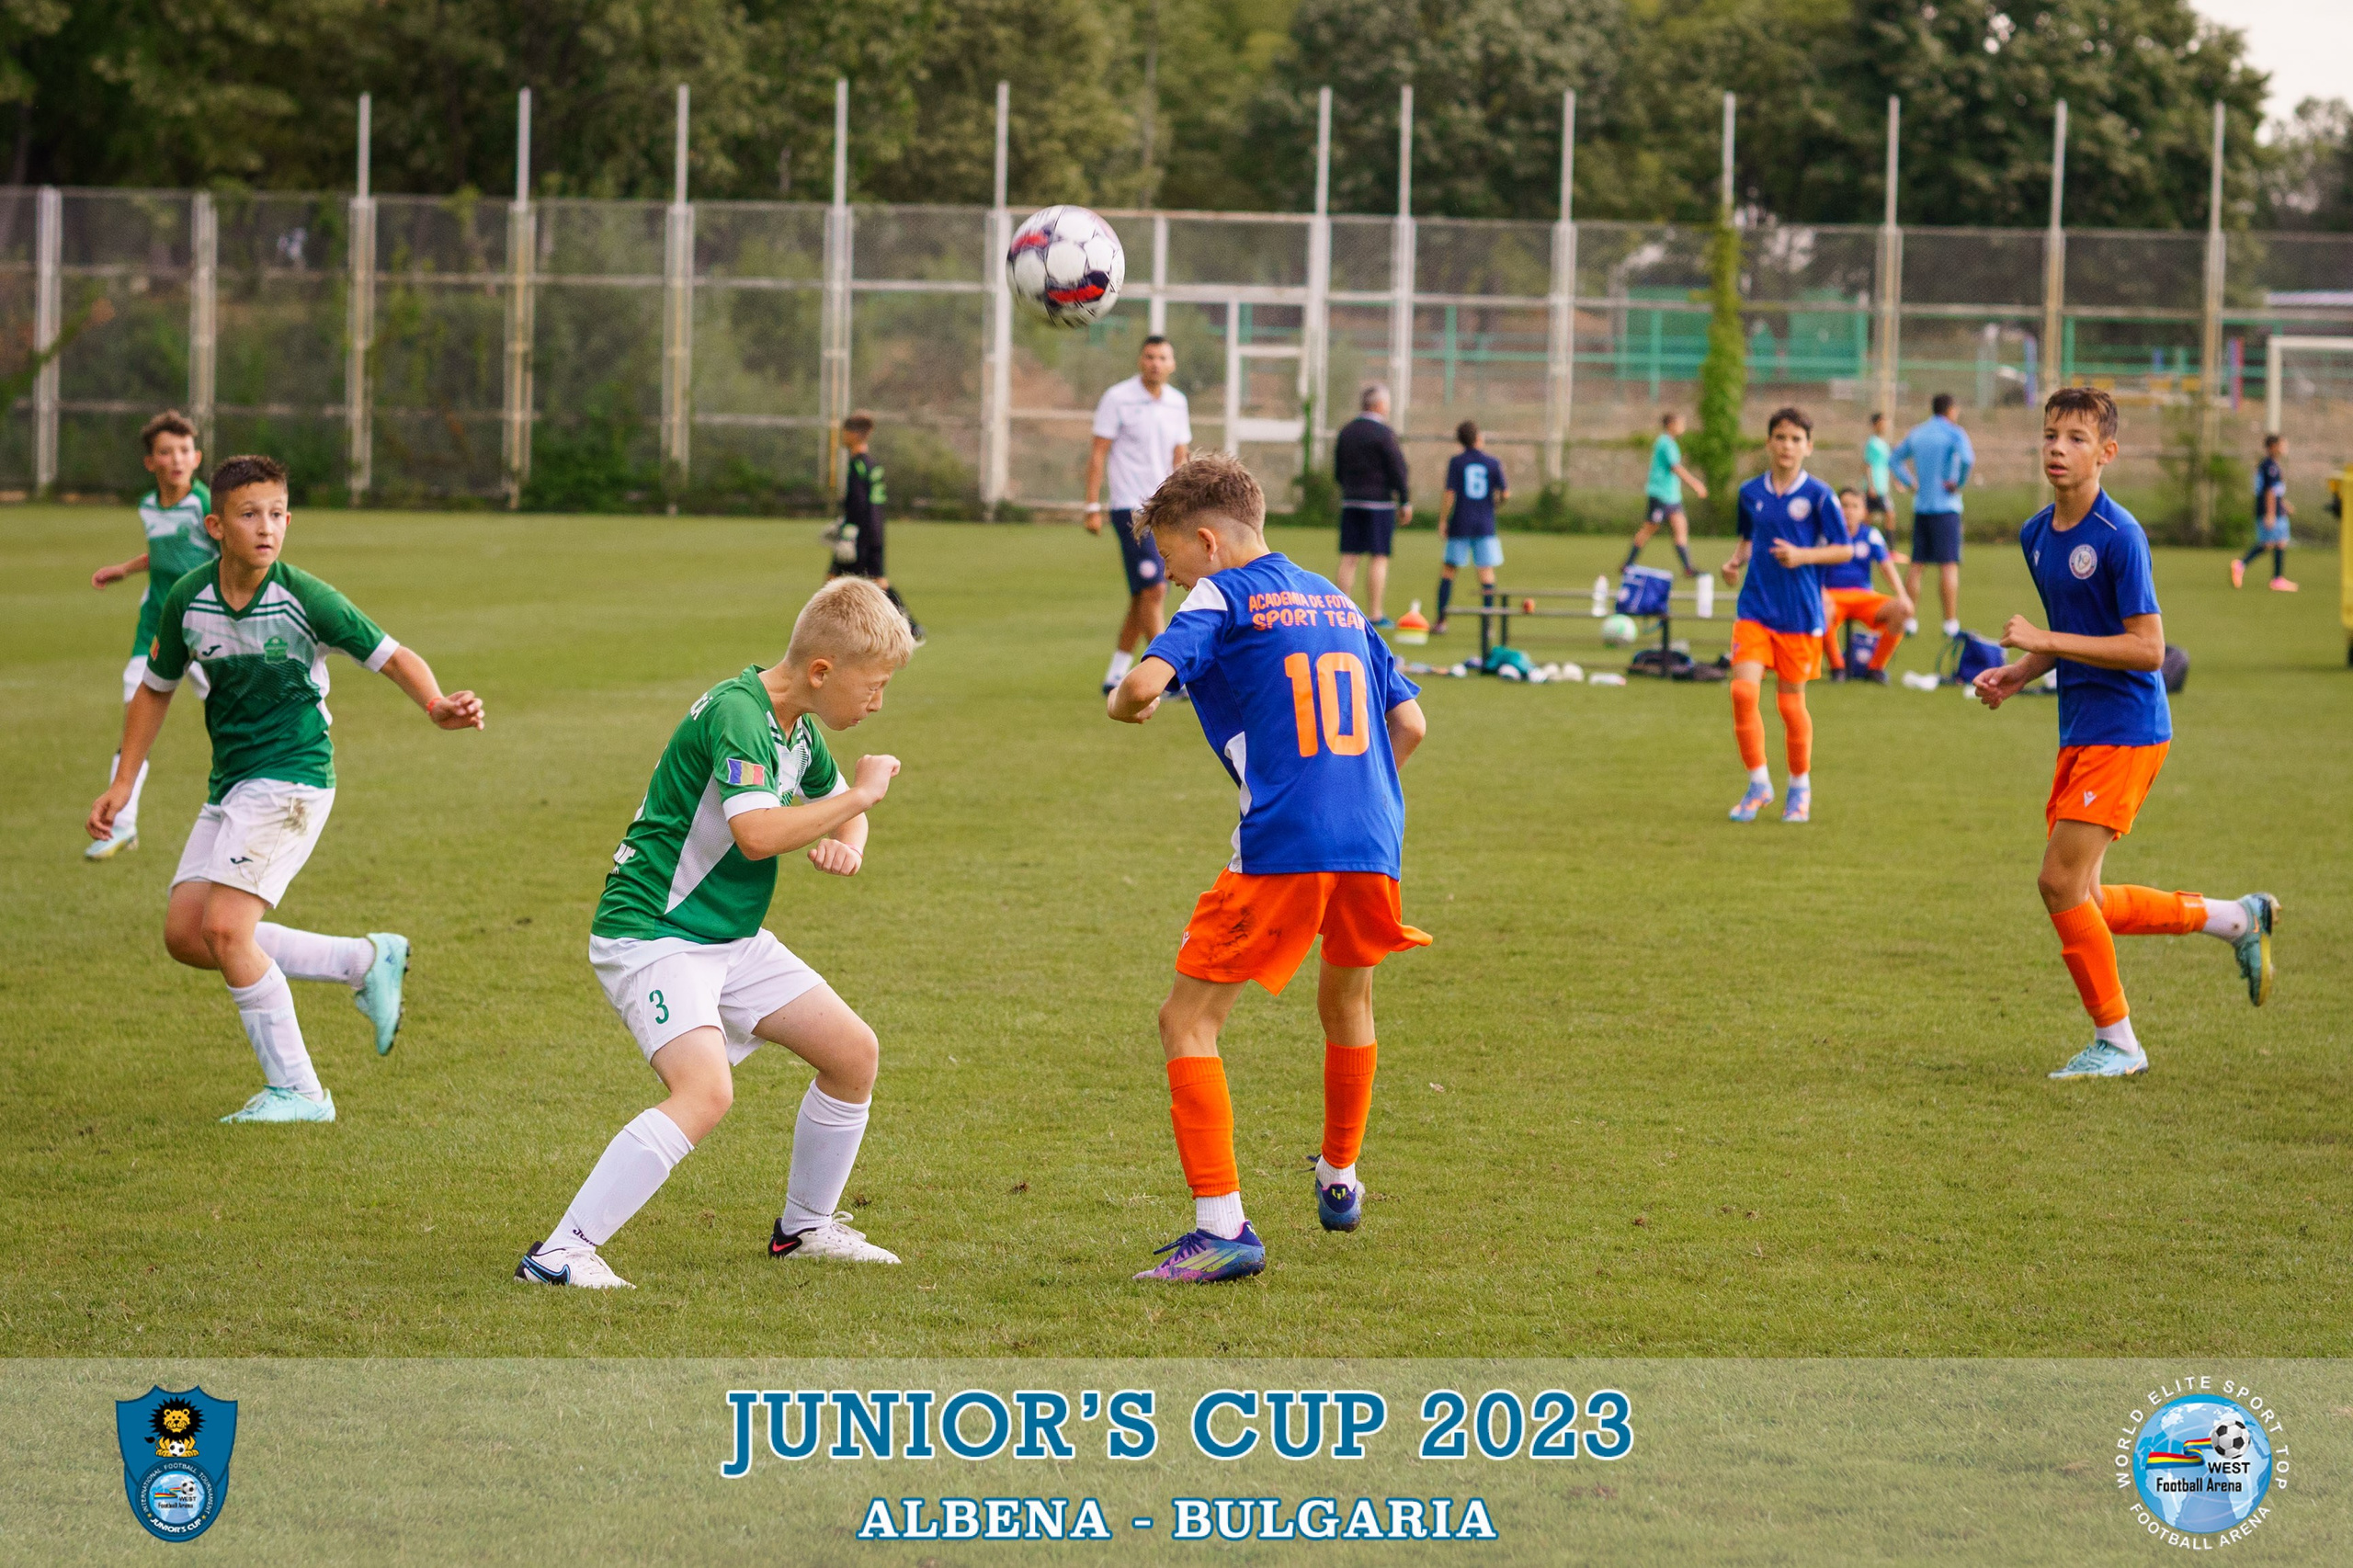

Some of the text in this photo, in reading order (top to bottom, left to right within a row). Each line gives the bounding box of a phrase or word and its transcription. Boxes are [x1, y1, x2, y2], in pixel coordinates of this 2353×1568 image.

[1464, 462, 1489, 499] 6
[1249, 591, 1309, 612] ACADEMIA
[1308, 594, 1325, 608] DE
[1252, 608, 1318, 631] SPORT
[1284, 652, 1370, 757] 10
[649, 990, 669, 1024] 3
